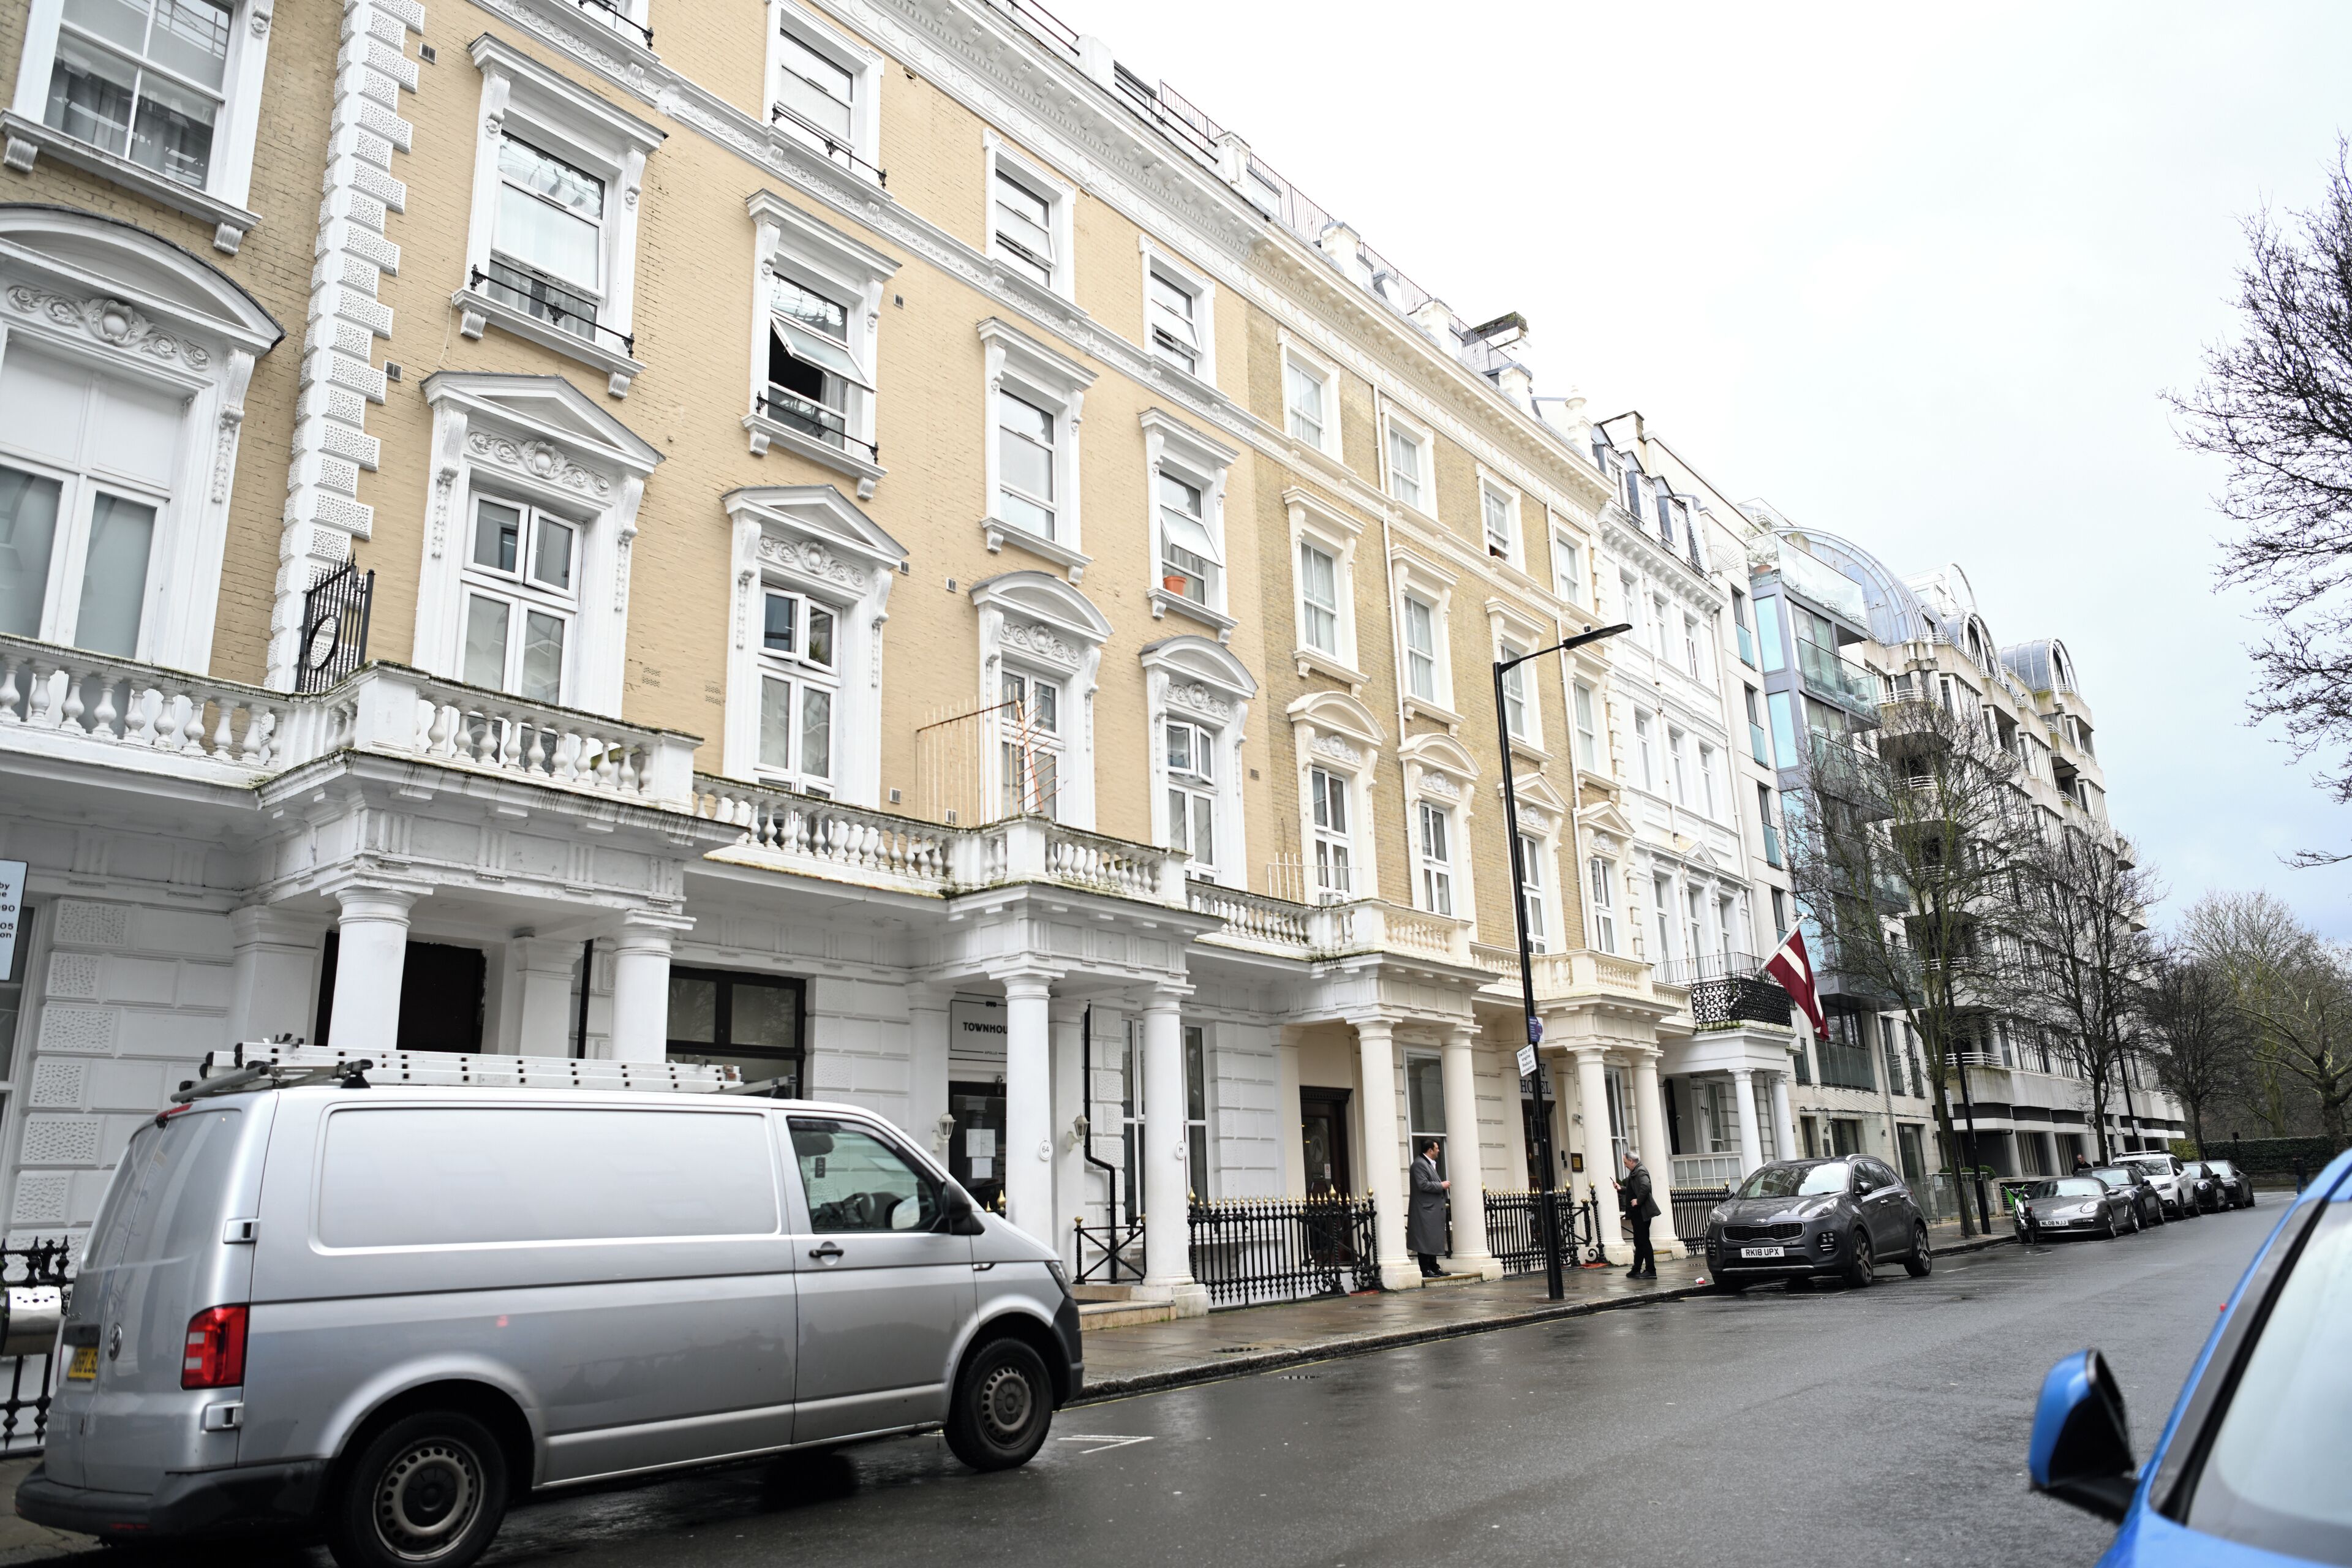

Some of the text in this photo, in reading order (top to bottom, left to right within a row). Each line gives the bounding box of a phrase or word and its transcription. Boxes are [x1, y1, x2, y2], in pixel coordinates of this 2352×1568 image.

[1520, 1079, 1551, 1095] HOEL
[1746, 1248, 1779, 1257] RK18 UPX
